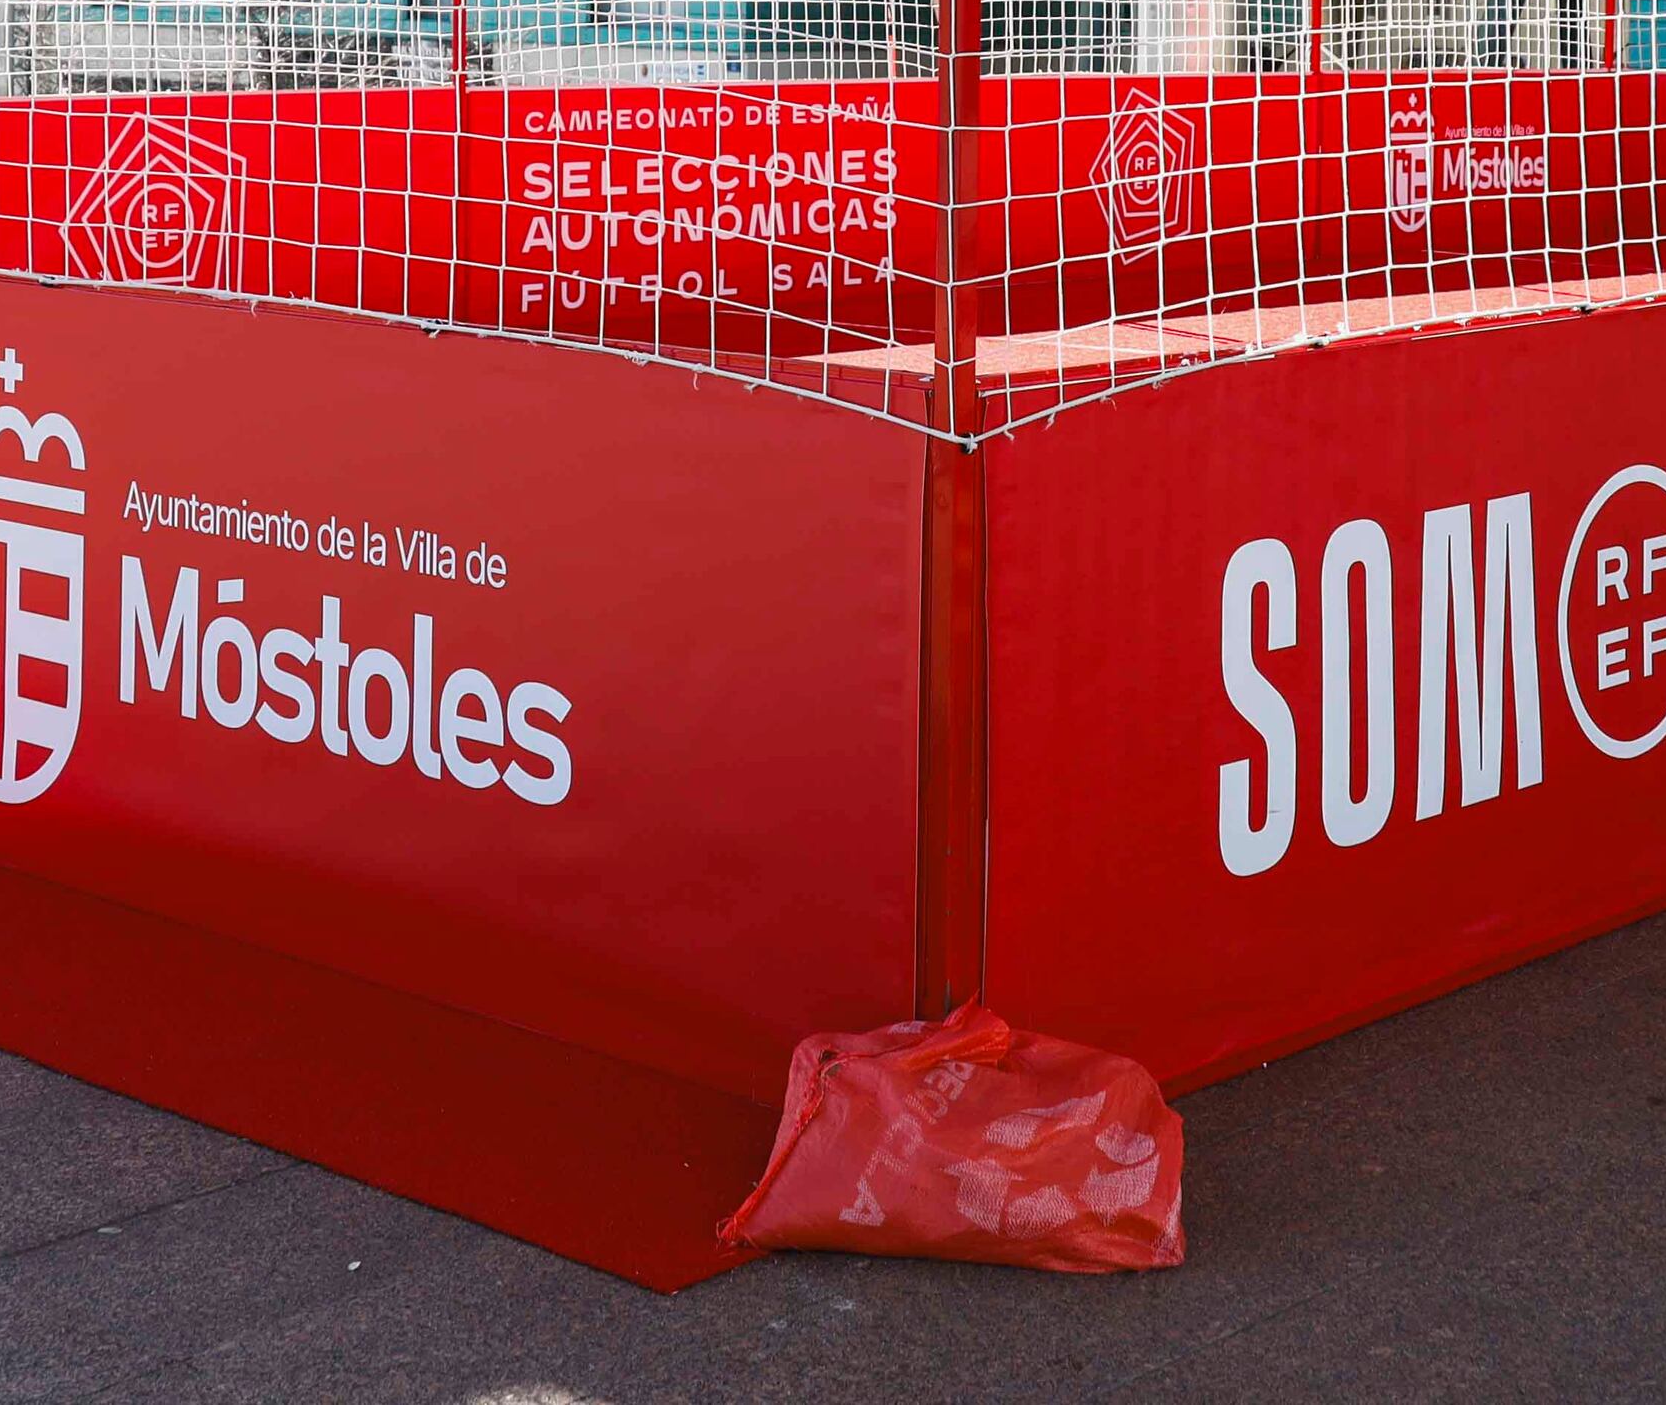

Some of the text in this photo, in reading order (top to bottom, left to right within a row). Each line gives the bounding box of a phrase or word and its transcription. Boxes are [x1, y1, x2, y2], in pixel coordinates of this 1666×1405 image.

[524, 96, 897, 133] CAMPEONATO DE ESPAÑA
[522, 147, 898, 201] SELECCIONES
[1442, 146, 1545, 192] Móstoles
[521, 193, 898, 254] AUTONÓMICAS
[773, 256, 896, 292] SALA
[123, 481, 507, 589] Ayuntamiento de la Villa de
[119, 554, 573, 806] Móstoles
